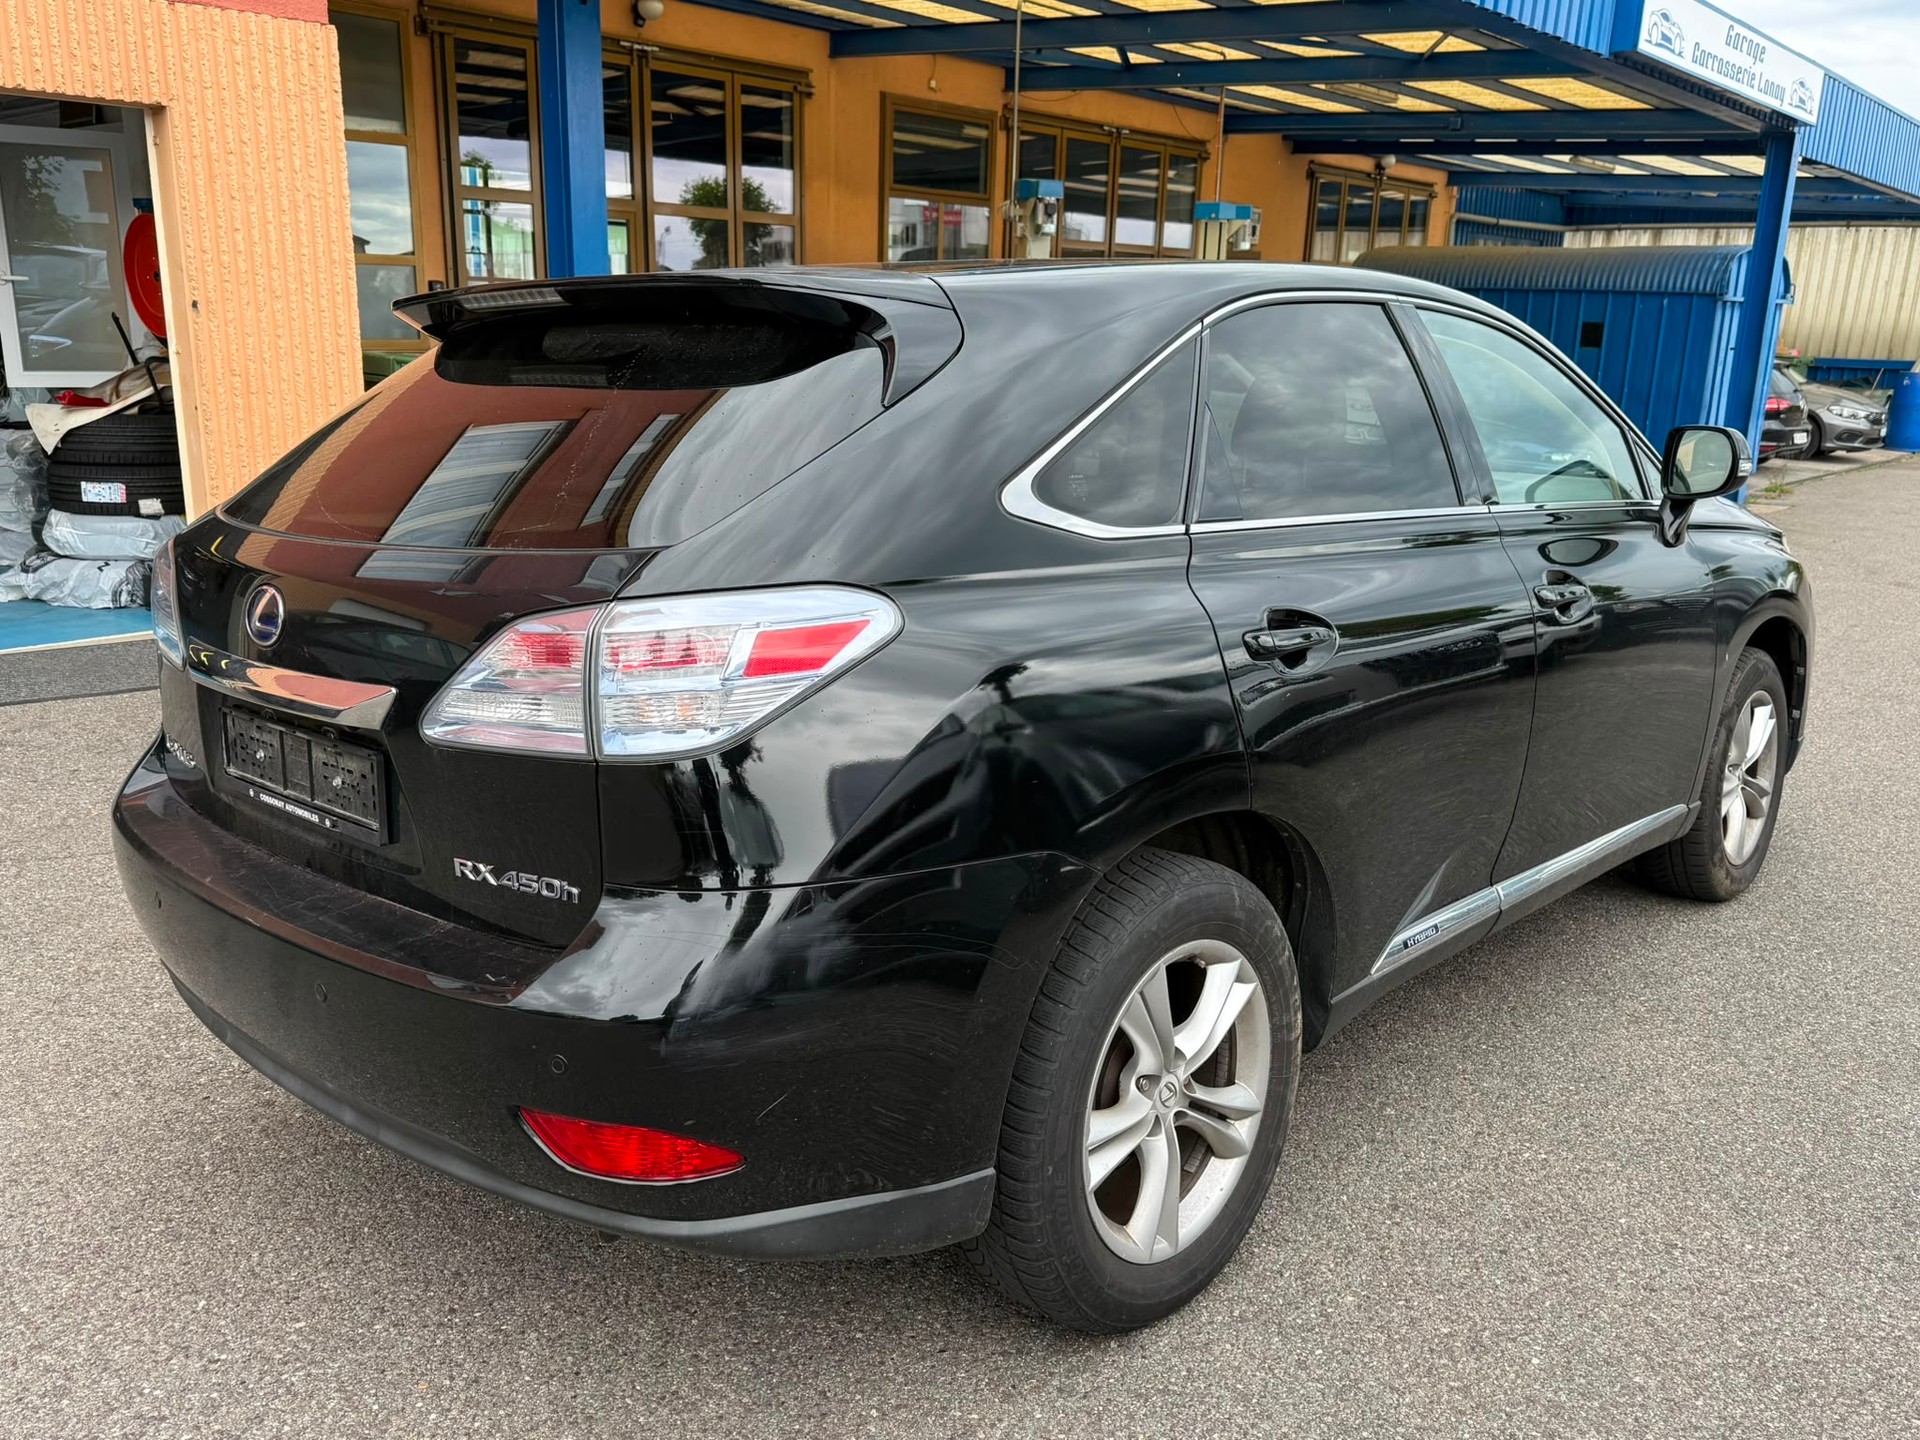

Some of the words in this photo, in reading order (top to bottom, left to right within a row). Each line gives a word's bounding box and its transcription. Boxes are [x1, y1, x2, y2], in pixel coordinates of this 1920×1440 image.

[1725, 24, 1766, 65] Garage
[1691, 41, 1756, 89] Carrosserie
[285, 803, 319, 823] AUTOMOBILES
[1407, 926, 1436, 947] HYBRID
